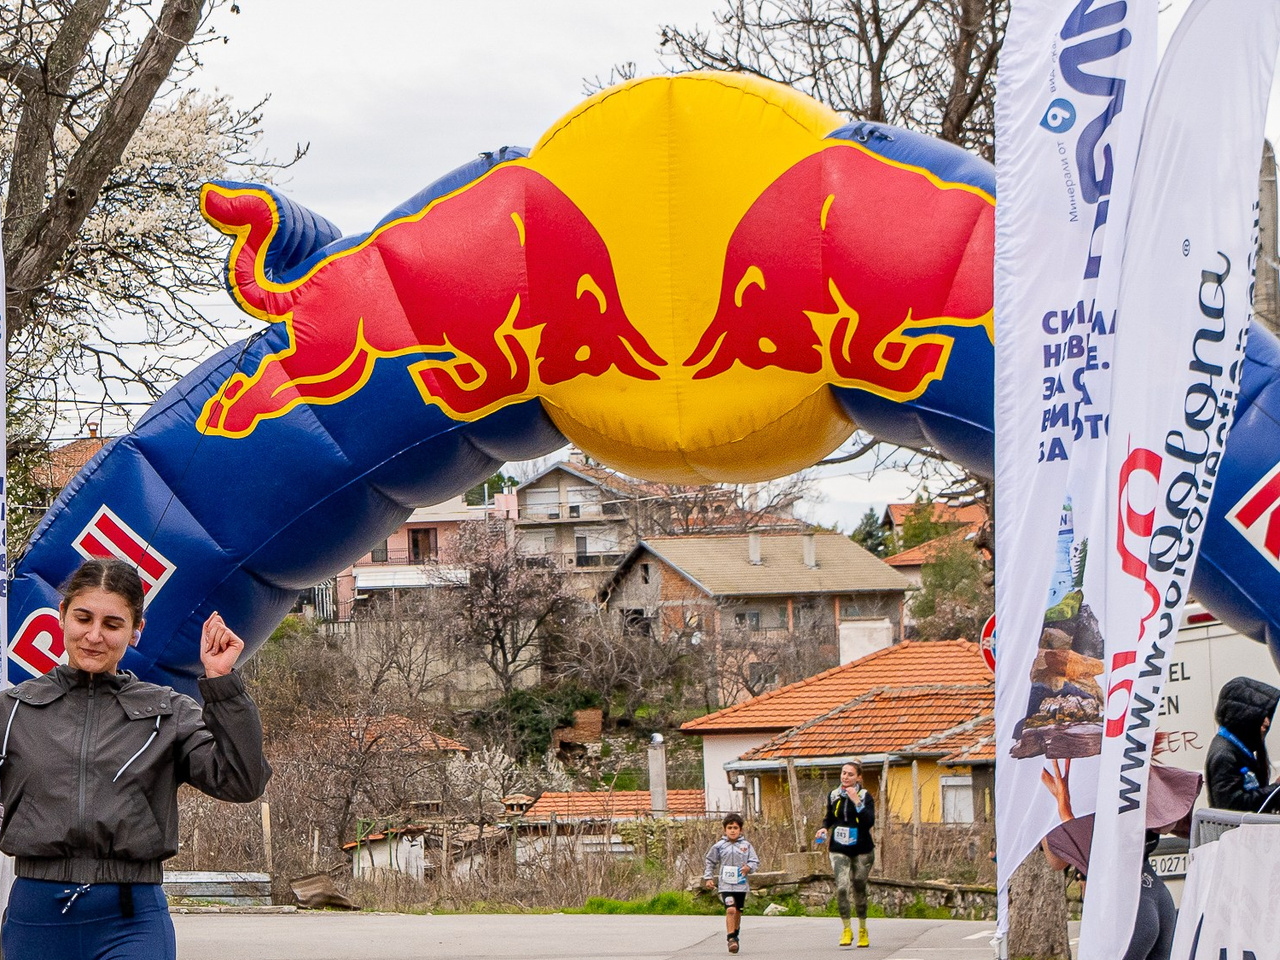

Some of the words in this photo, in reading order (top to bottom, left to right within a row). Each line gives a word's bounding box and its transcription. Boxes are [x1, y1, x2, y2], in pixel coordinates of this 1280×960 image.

[1047, 107, 1070, 129] 9
[1057, 141, 1067, 156] от
[1063, 156, 1078, 222] Минерали
[1160, 856, 1187, 873] 0271
